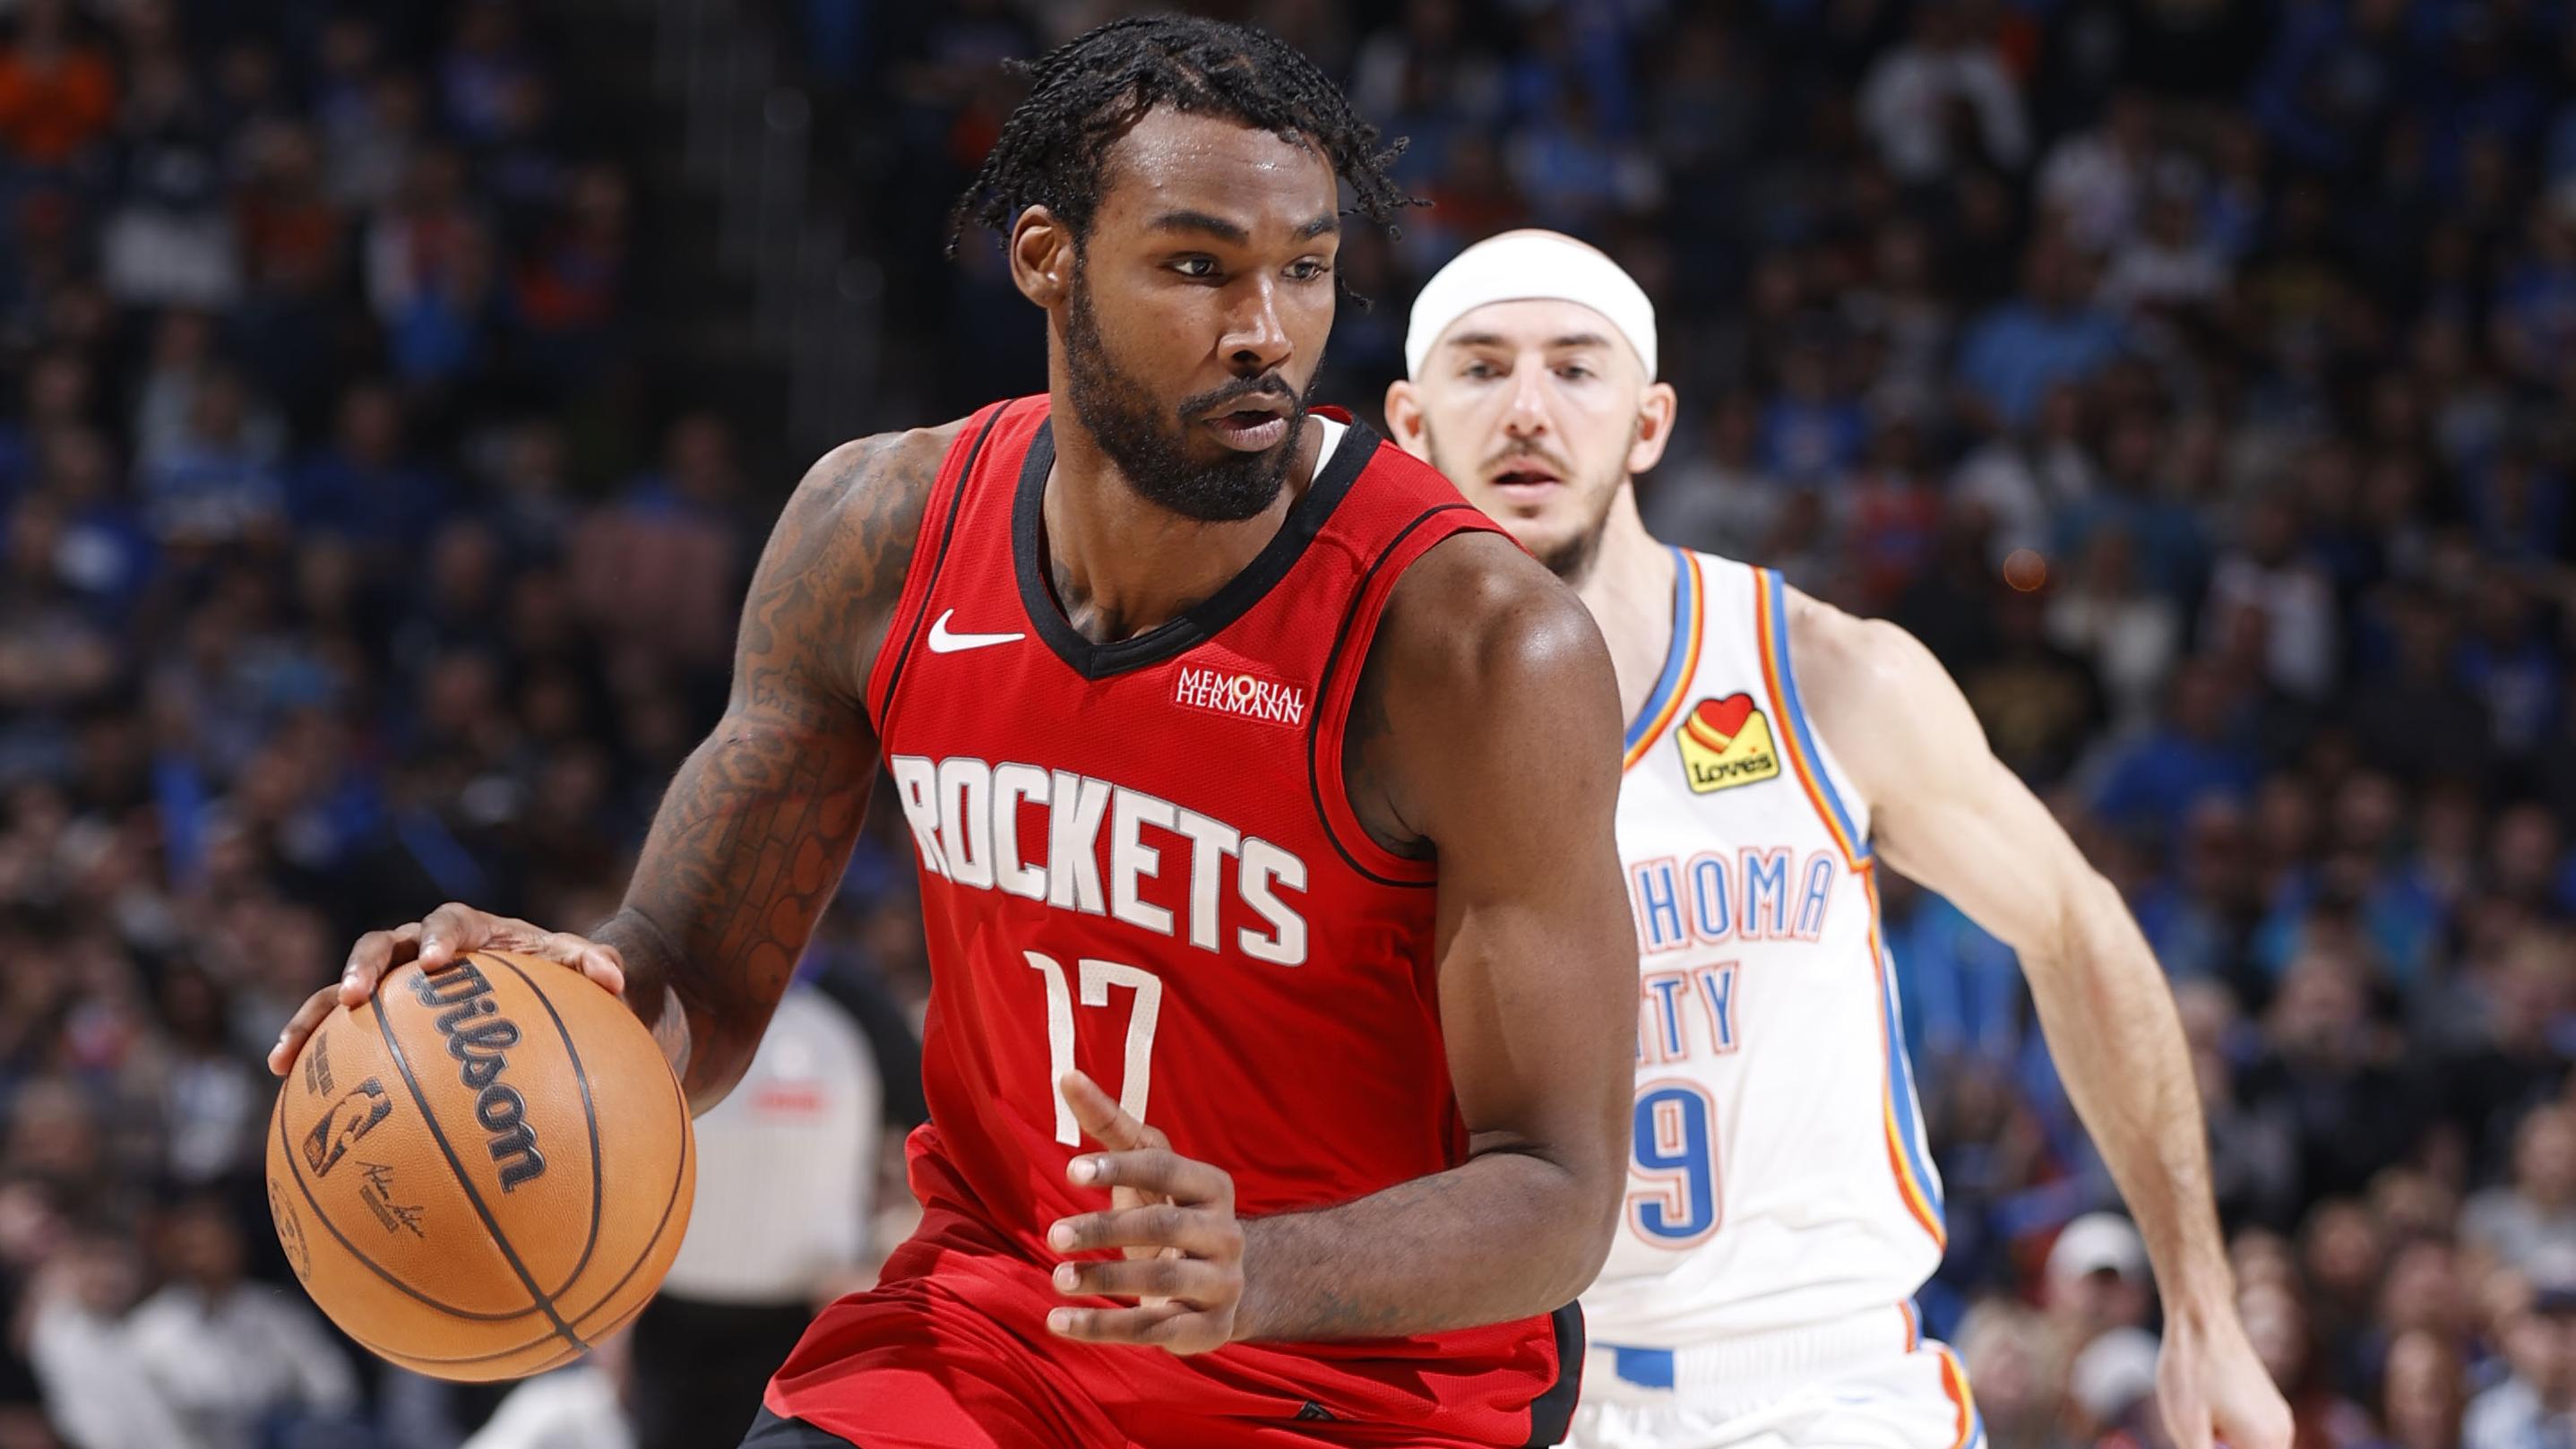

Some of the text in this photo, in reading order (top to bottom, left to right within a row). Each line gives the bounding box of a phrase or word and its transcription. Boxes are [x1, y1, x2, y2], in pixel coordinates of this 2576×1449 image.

[1176, 683, 1303, 725] HERMANN
[1178, 667, 1305, 708] MEMORIAL
[891, 755, 1308, 968] ROCKETS
[407, 956, 547, 1195] Wilson
[1022, 950, 1163, 1148] 17
[1627, 1078, 1724, 1251] 9
